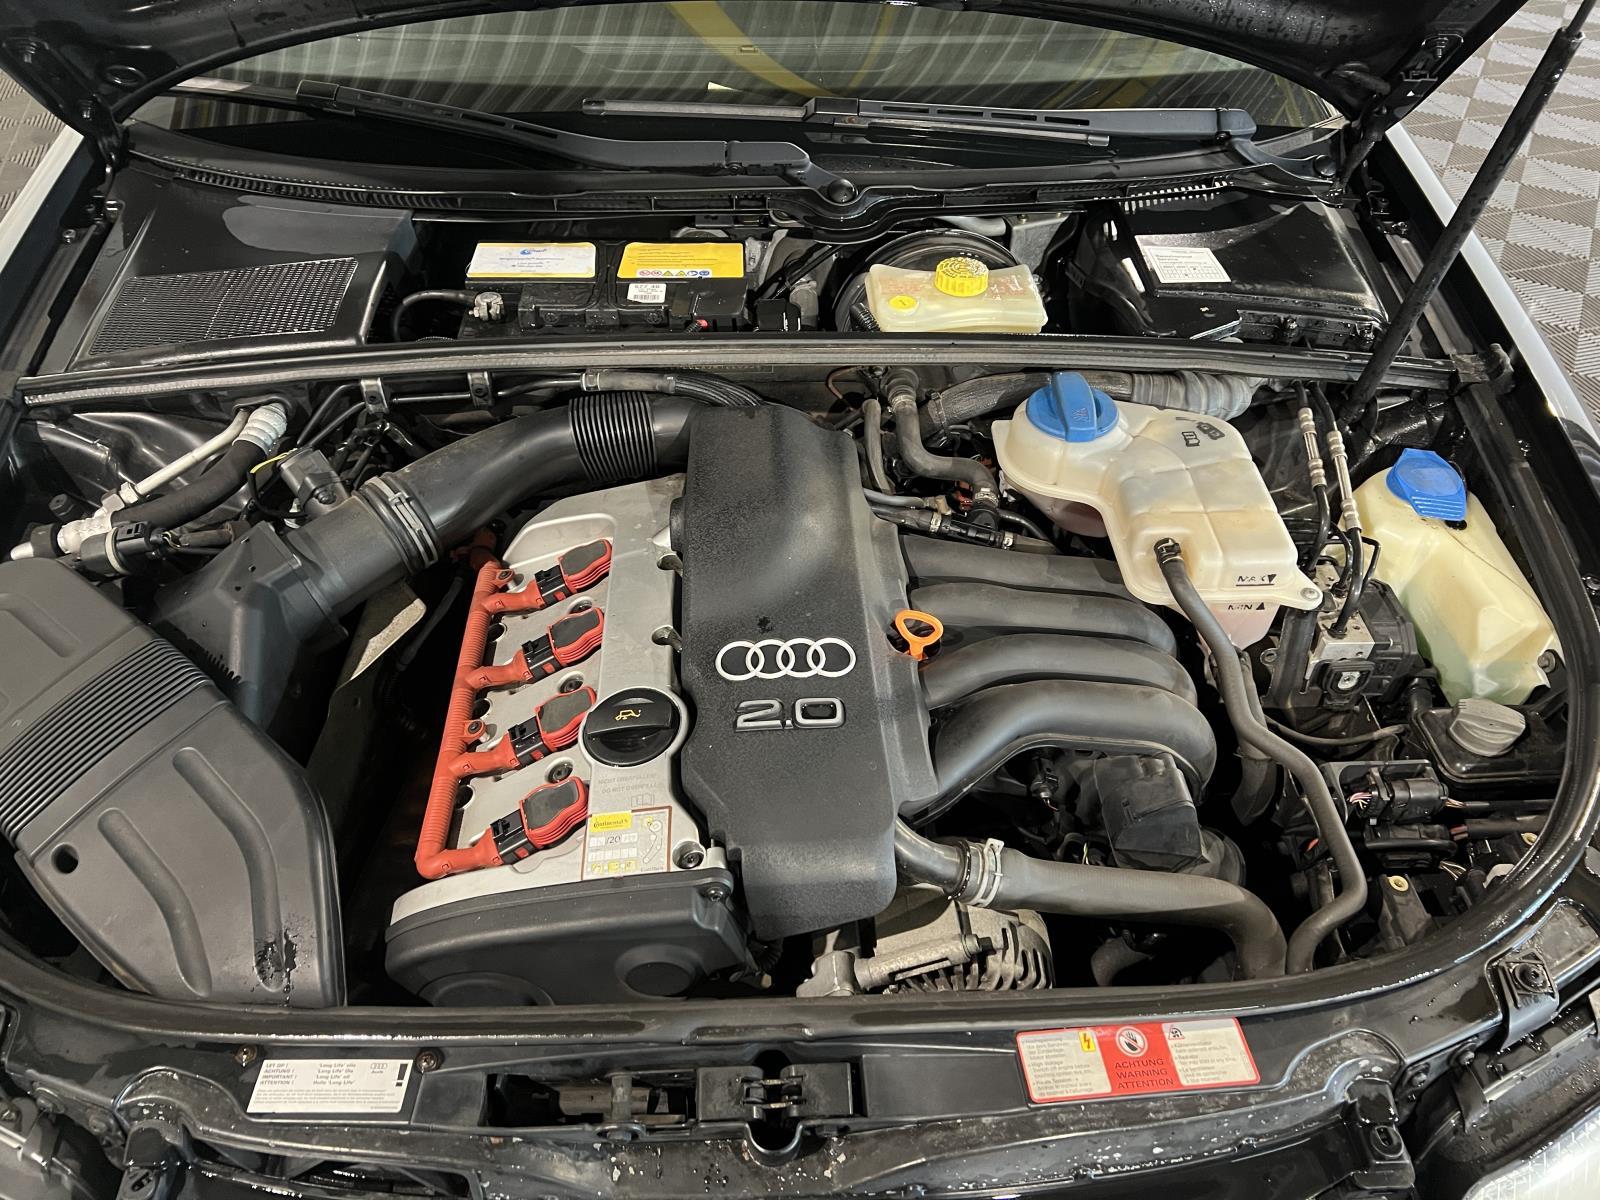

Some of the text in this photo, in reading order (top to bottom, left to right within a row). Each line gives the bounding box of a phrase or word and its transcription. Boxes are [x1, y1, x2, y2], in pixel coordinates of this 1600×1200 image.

[734, 698, 845, 732] 2.0
[1114, 1058, 1165, 1070] ACHTUNG
[1116, 1067, 1168, 1079] WARNING
[1118, 1077, 1174, 1089] ATTENTION
